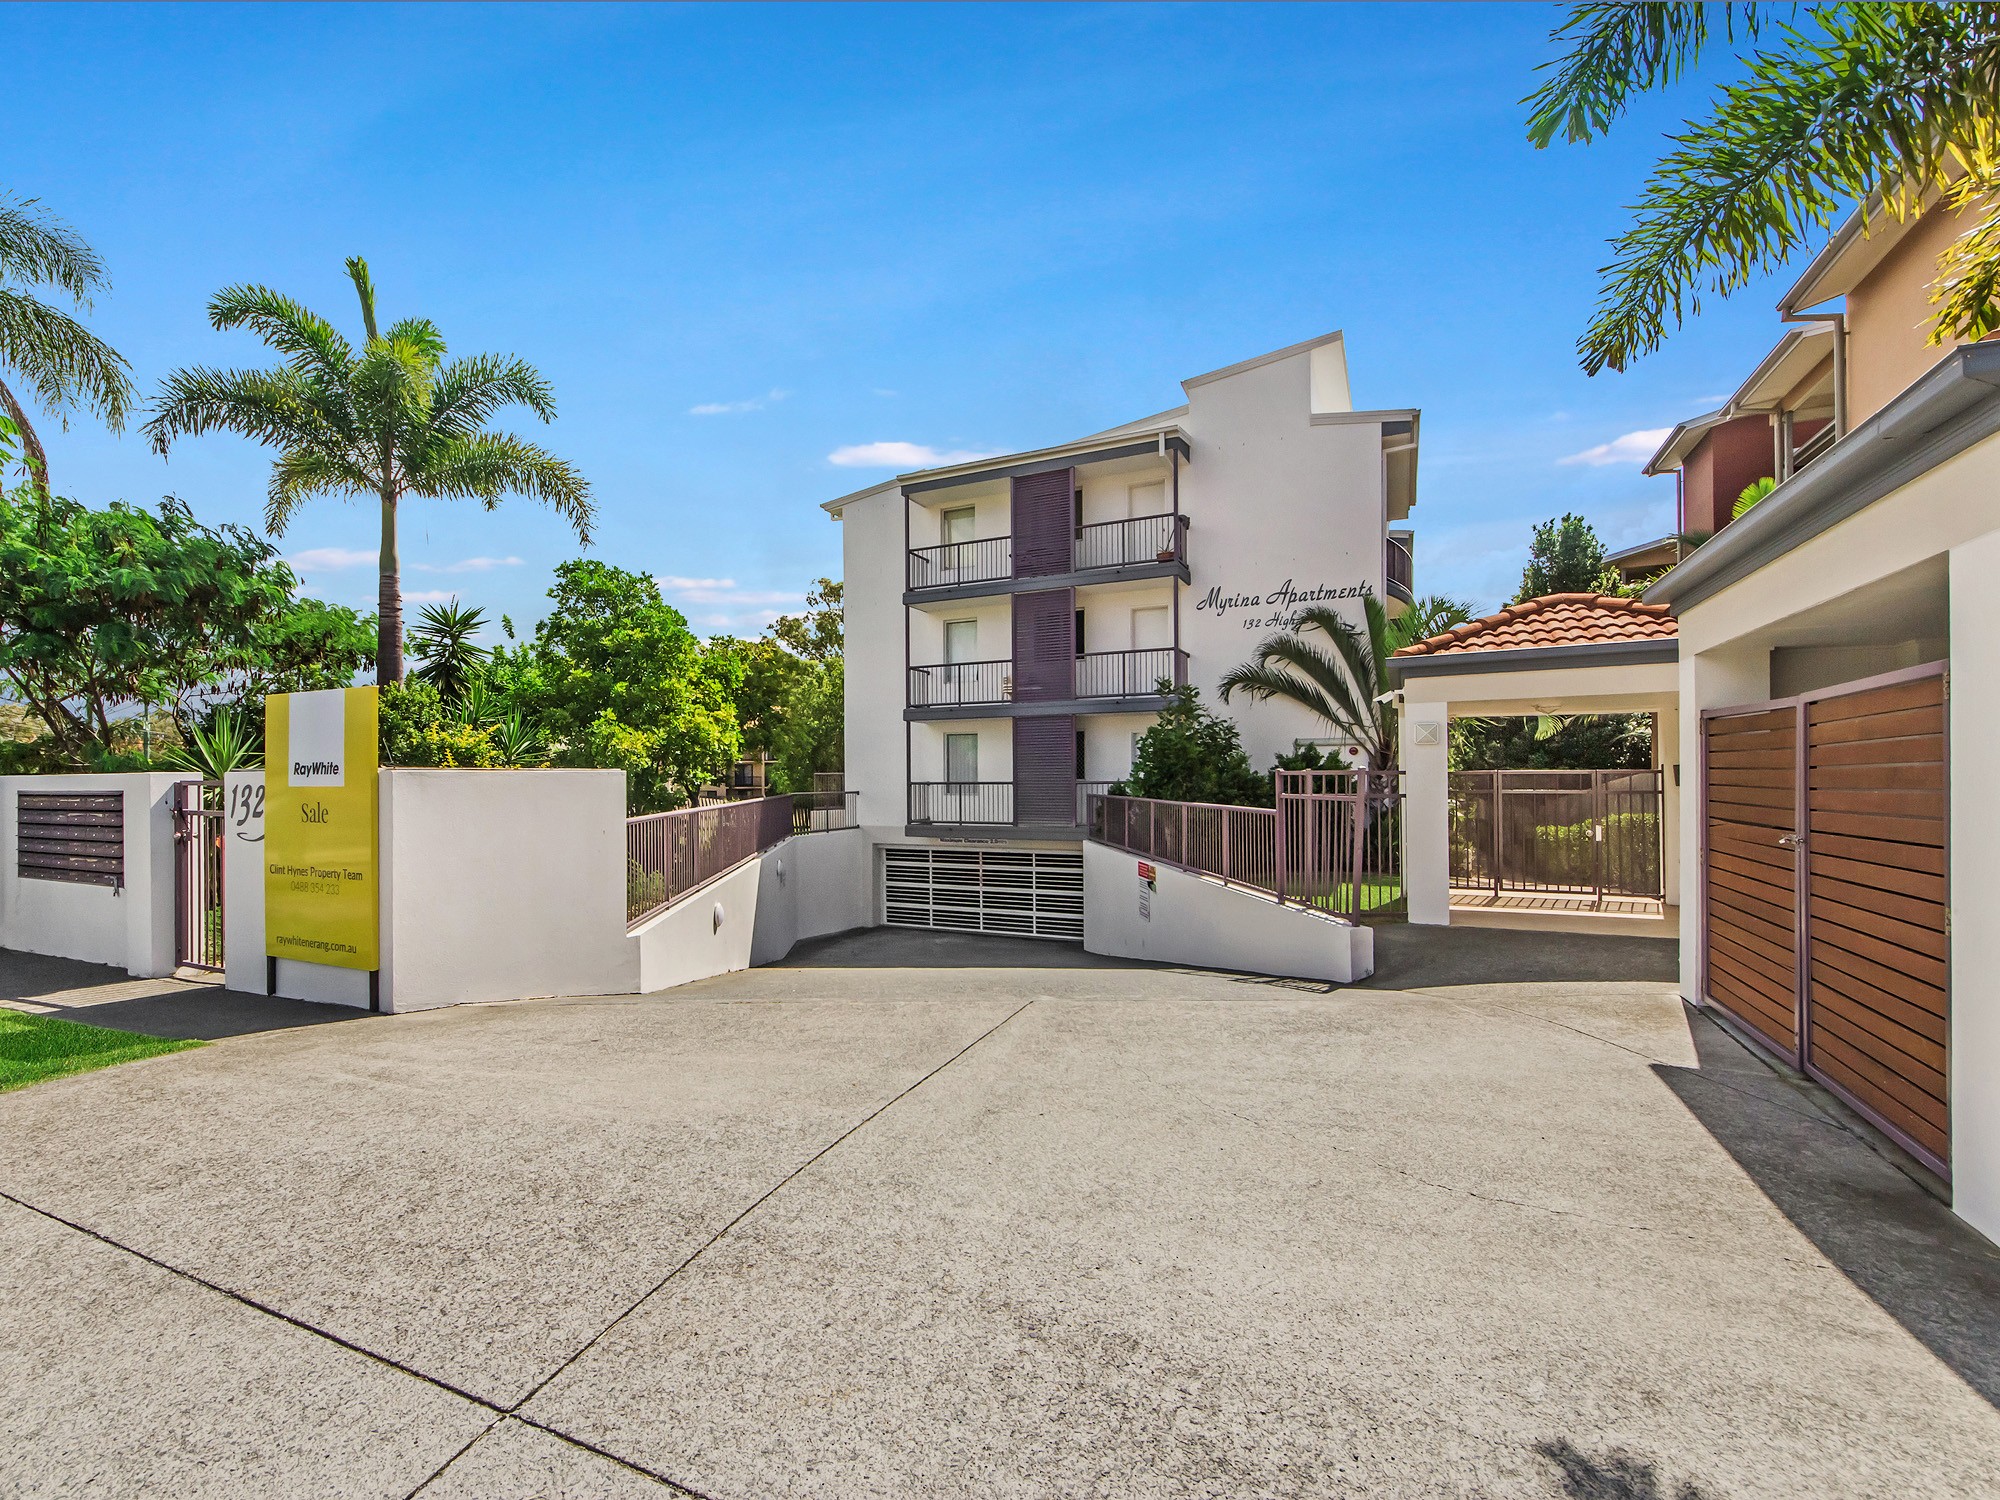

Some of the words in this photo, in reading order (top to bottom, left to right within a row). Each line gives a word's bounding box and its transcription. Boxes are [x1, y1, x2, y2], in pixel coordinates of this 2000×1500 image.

[1196, 585, 1260, 616] Myrina
[1266, 579, 1374, 611] Apartments
[1242, 619, 1262, 630] 132
[230, 784, 266, 827] 132
[301, 801, 329, 824] Sale
[269, 863, 286, 875] Clint
[287, 865, 309, 878] Hynes
[310, 866, 342, 881] Property
[342, 868, 363, 881] Team
[276, 935, 357, 954] raywhitenerang.com.au
